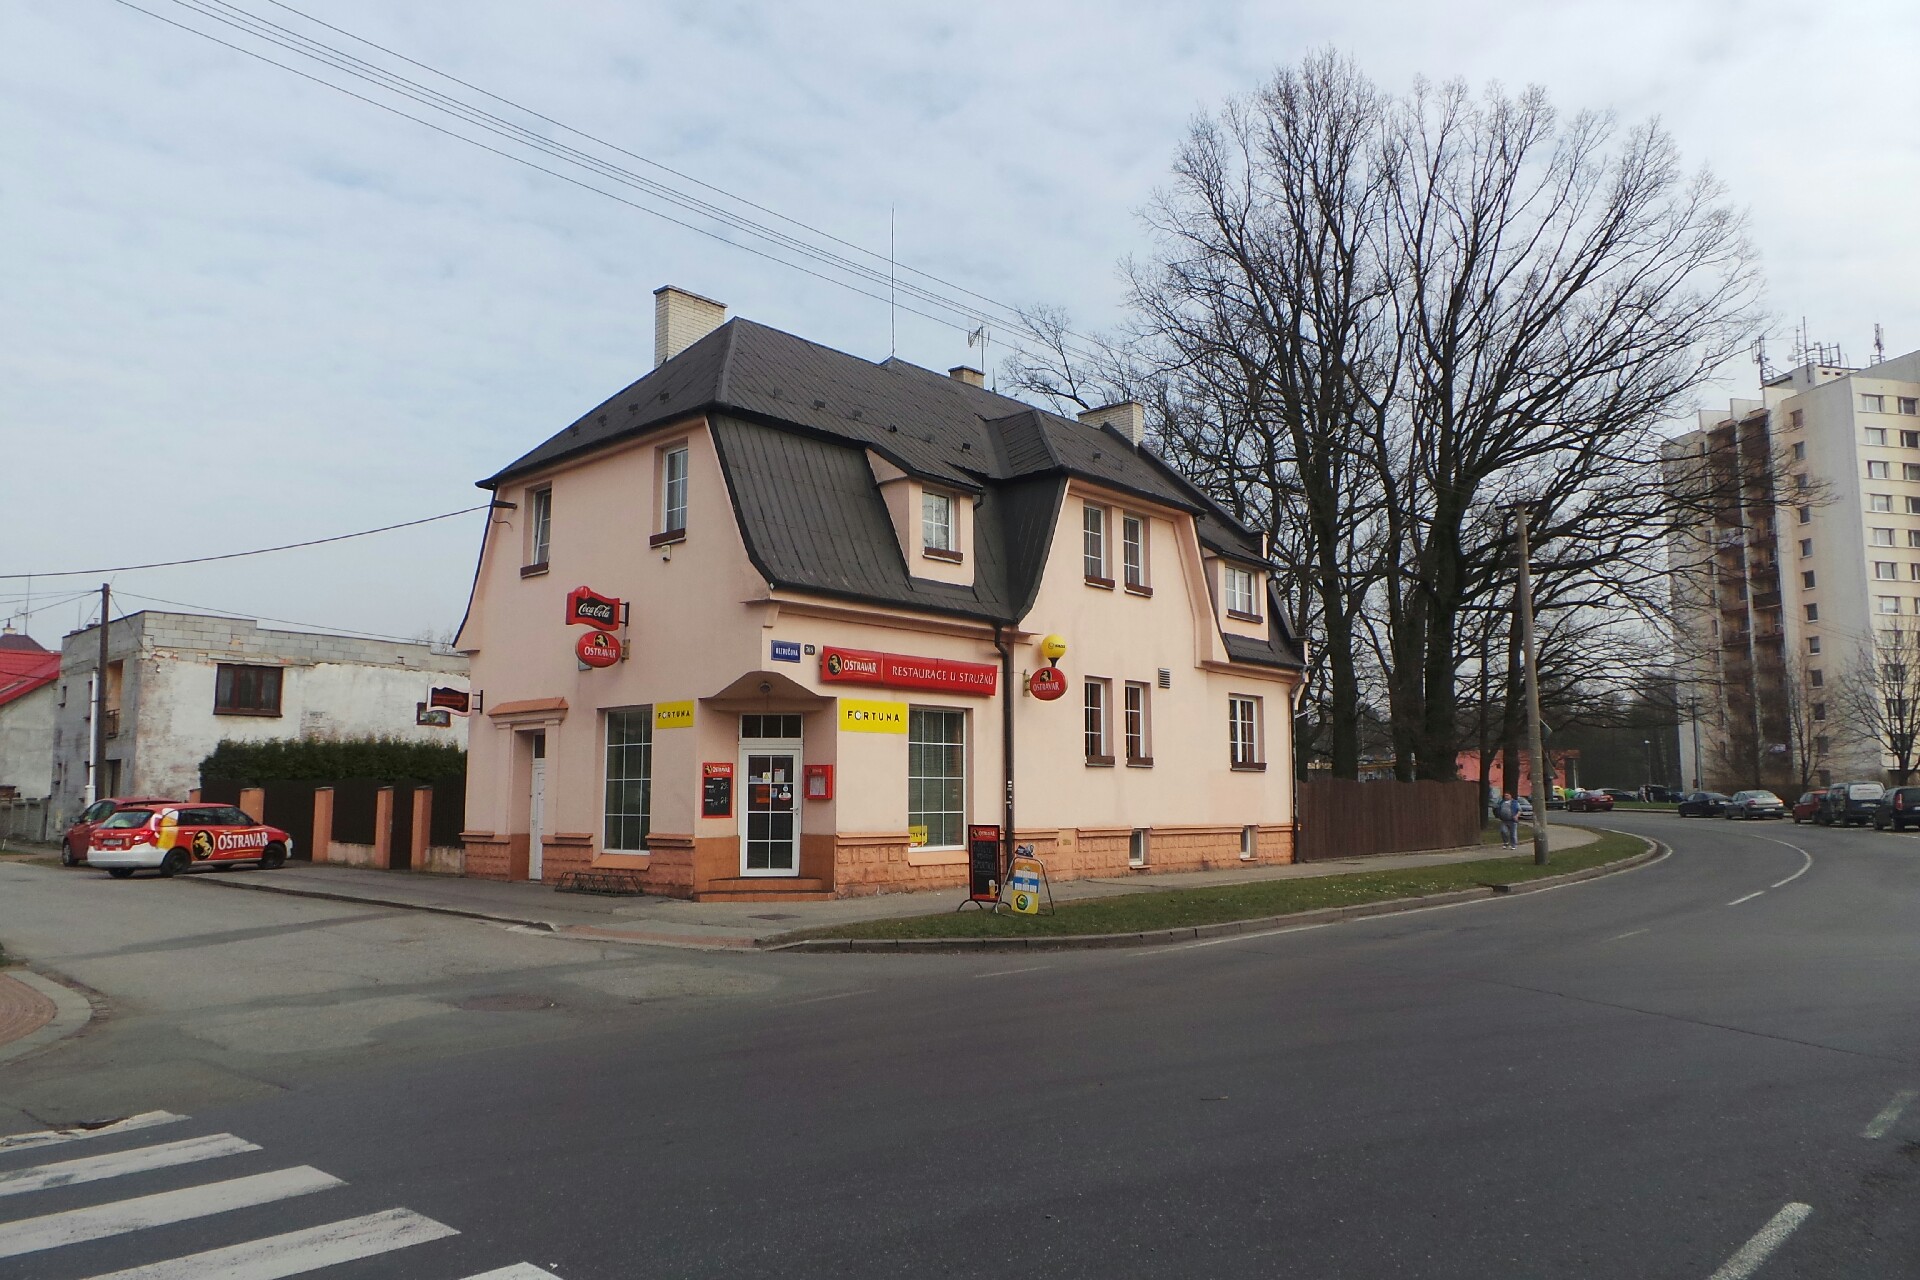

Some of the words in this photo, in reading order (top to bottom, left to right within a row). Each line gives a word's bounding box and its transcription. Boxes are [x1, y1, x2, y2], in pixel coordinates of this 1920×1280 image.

[584, 646, 617, 658] OSTRAVAR
[843, 659, 877, 673] OSTRAVAR
[892, 665, 947, 681] RESTAURACE
[950, 672, 956, 681] U
[959, 672, 994, 685] STRUŽKŮ
[1032, 681, 1060, 691] OSTRAVAR
[658, 710, 690, 719] FORTUNA
[847, 710, 900, 722] FORTUNA
[218, 832, 269, 850] OSTRAVAR
